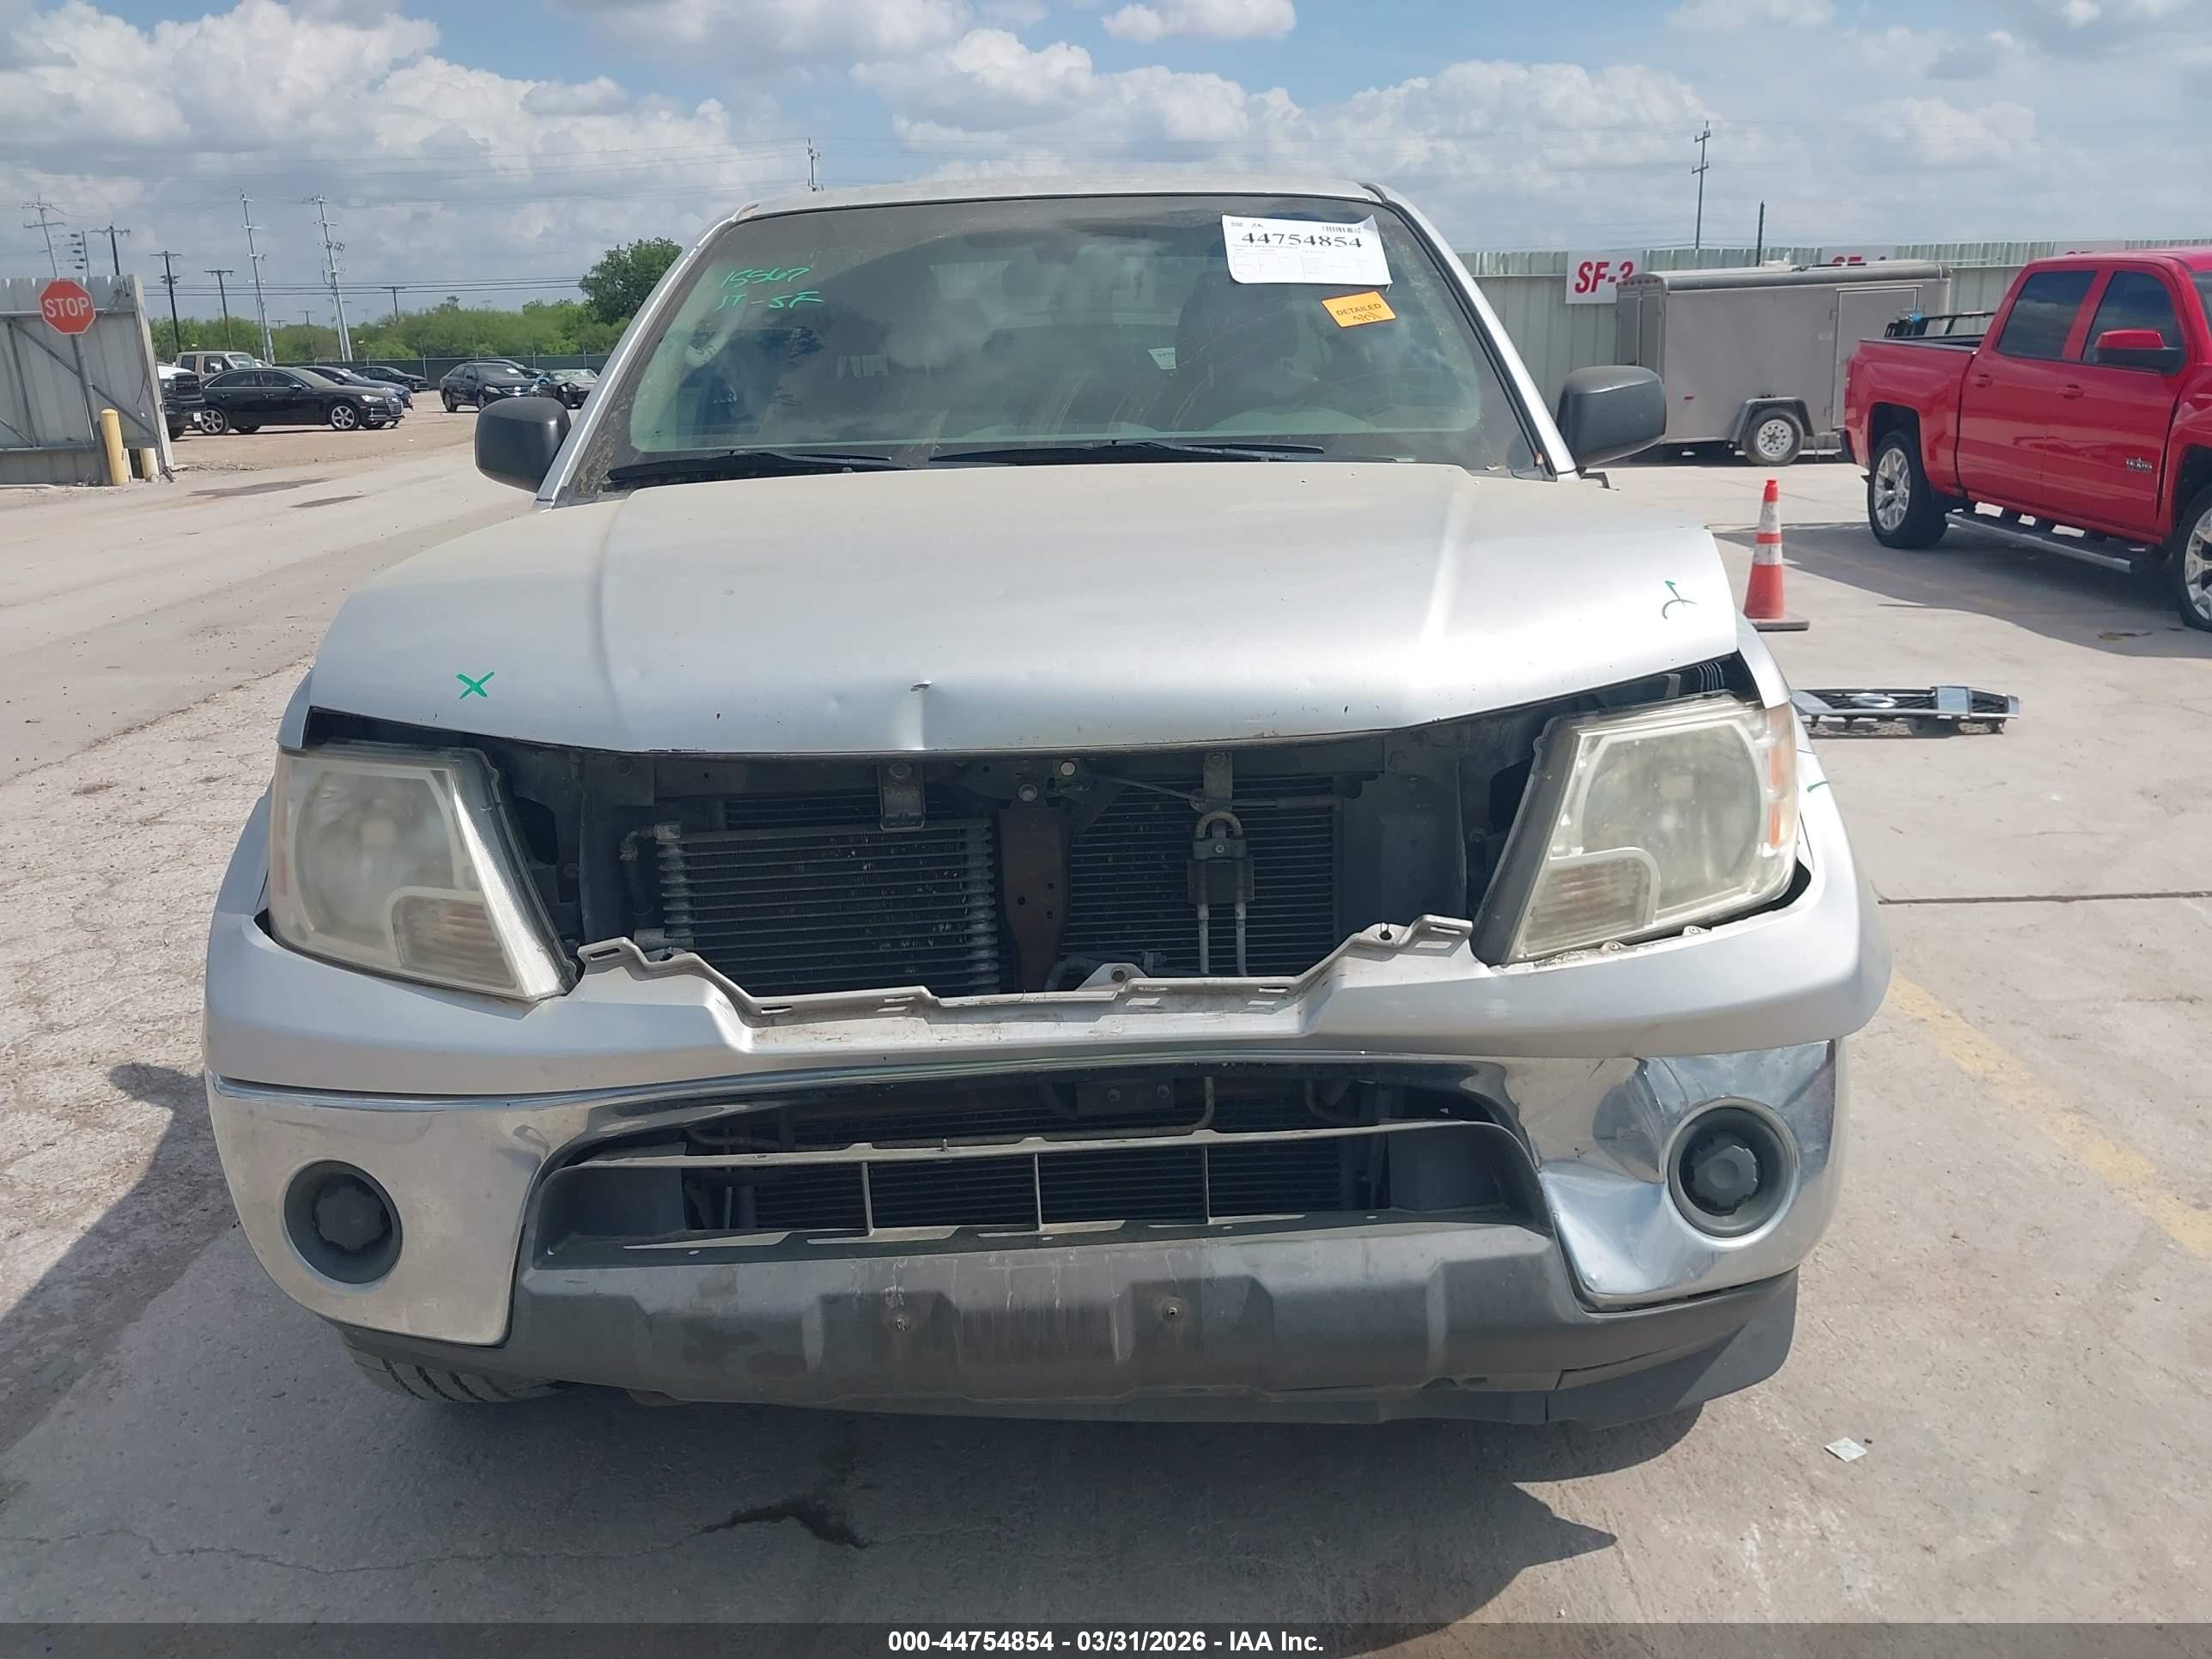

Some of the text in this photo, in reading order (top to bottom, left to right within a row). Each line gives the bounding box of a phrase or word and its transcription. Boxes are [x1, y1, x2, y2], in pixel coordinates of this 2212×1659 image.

[1242, 232, 1363, 248] 44754854
[44, 296, 89, 319] STOP
[1335, 303, 1382, 316] DETAILED
